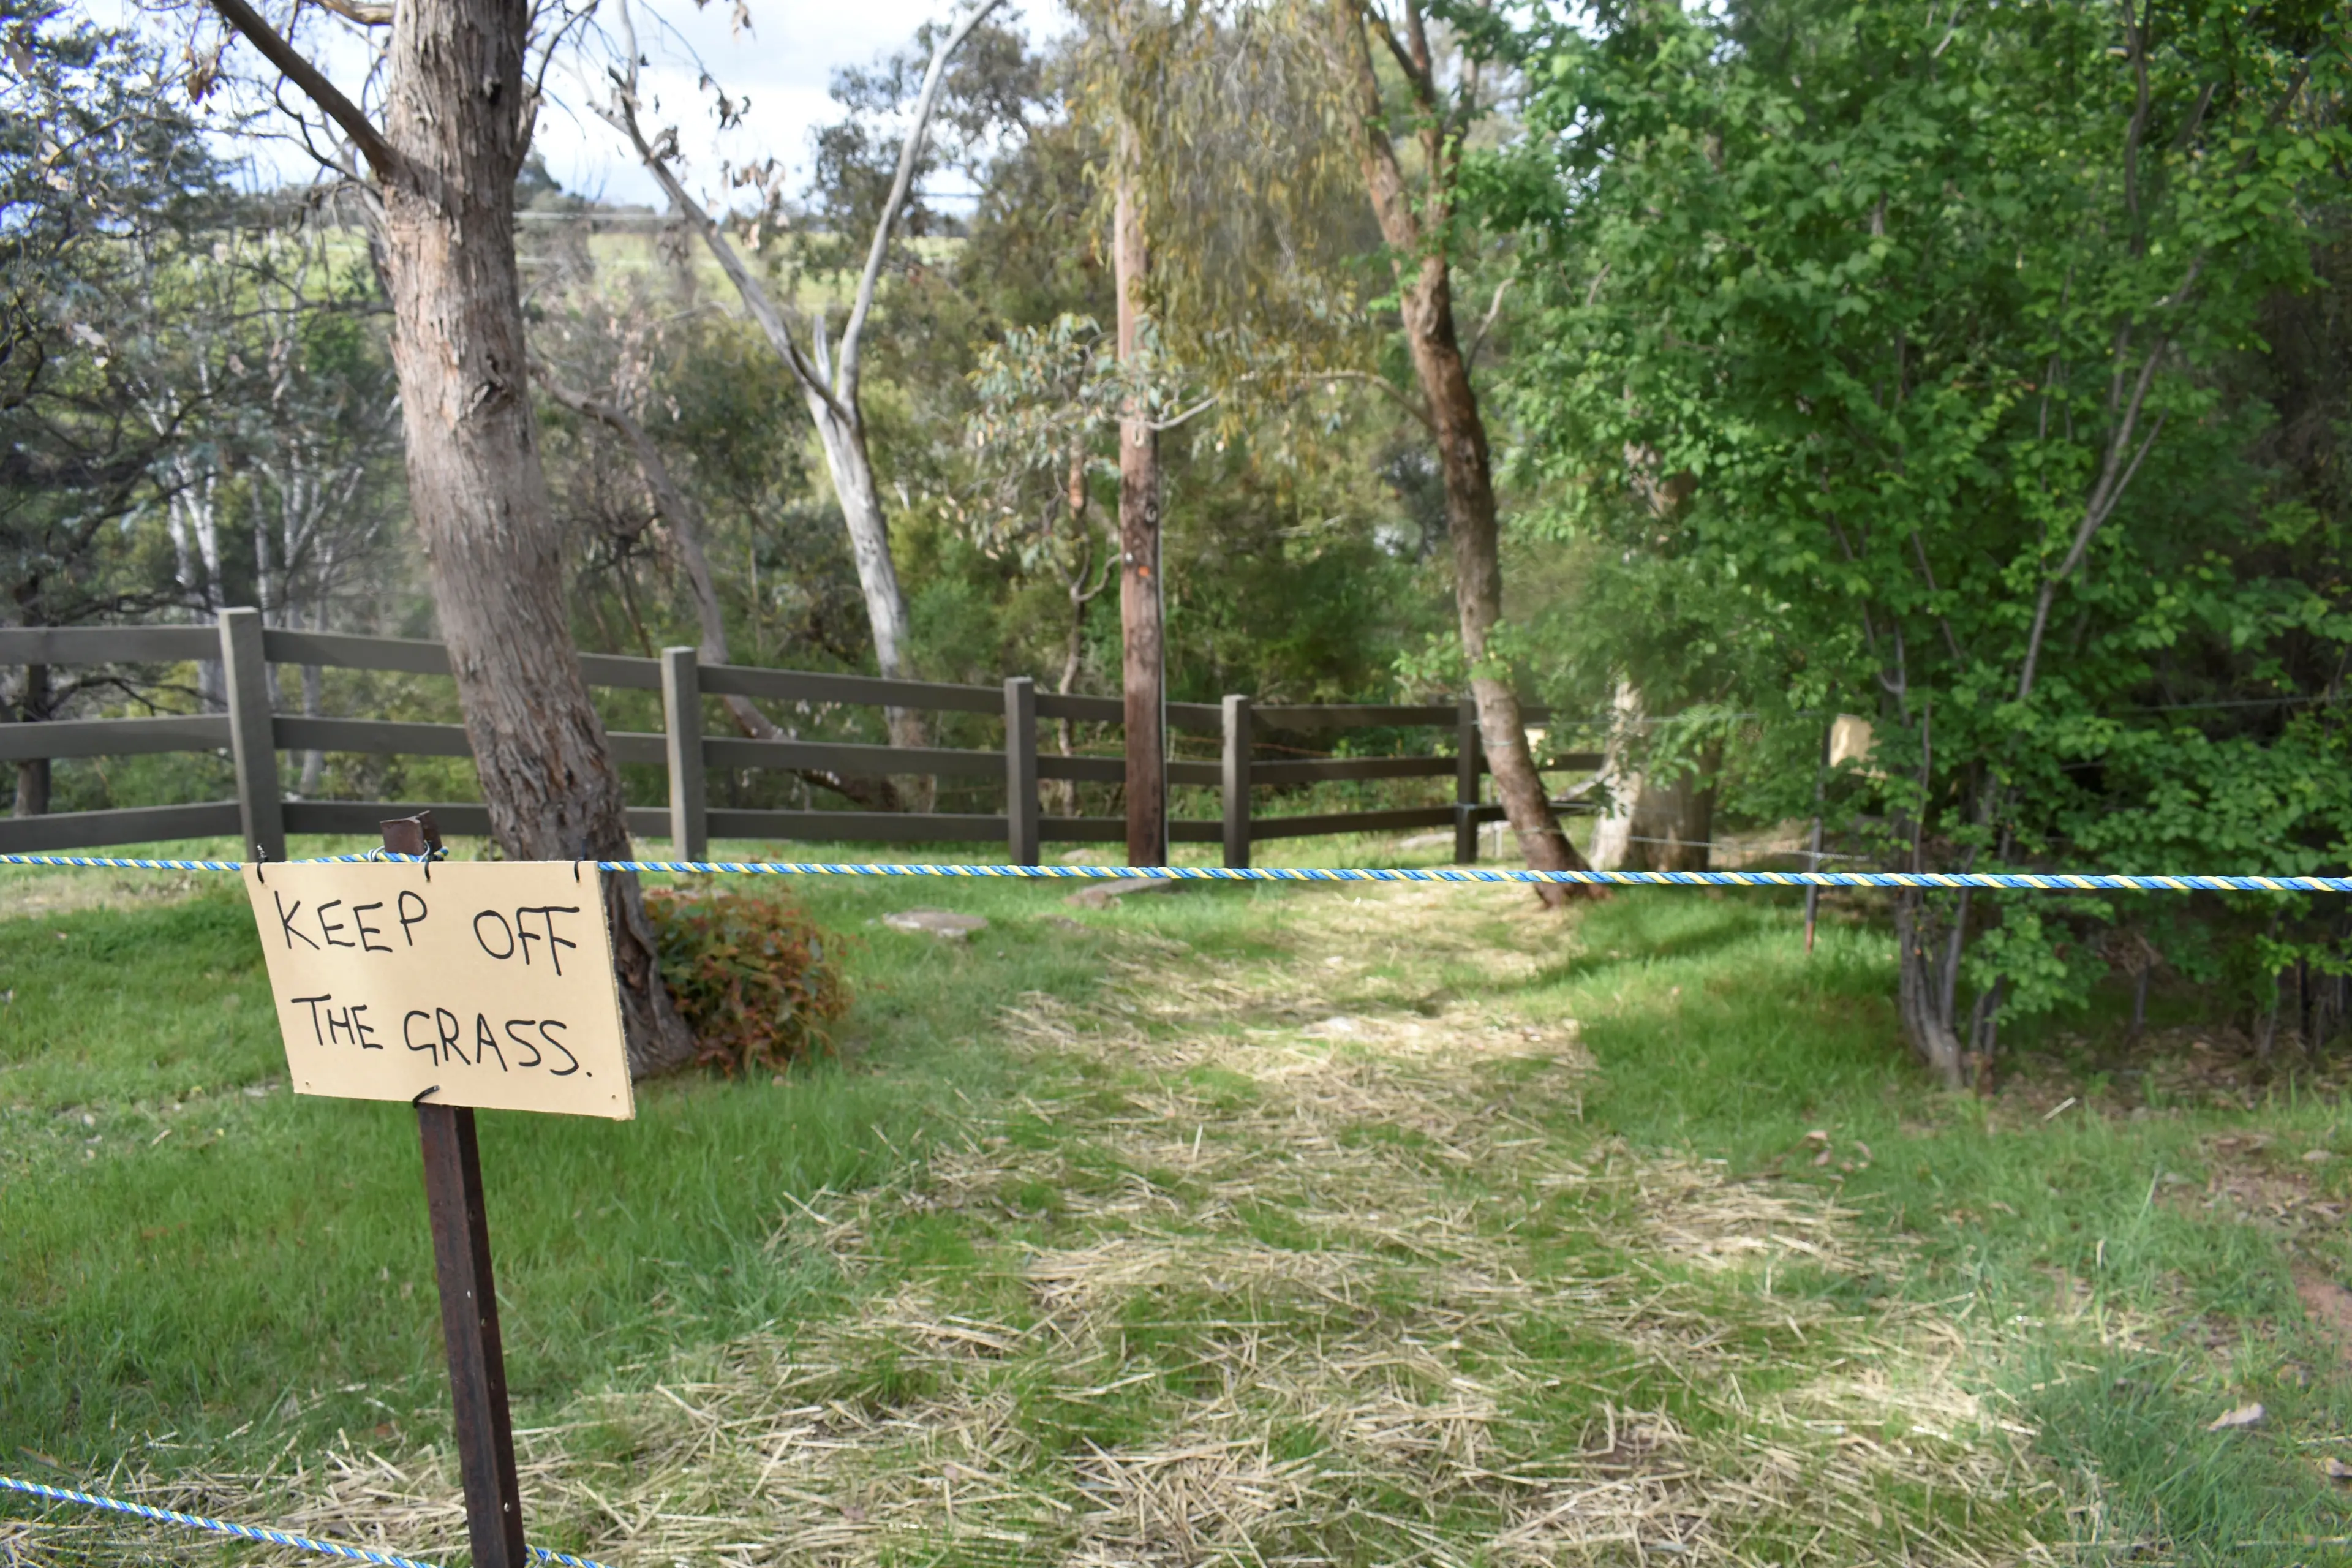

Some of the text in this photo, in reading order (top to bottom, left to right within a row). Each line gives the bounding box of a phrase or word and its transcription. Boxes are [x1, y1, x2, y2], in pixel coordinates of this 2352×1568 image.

[274, 891, 580, 976] KEEP OFF
[291, 993, 592, 1077] THE GRASS.
